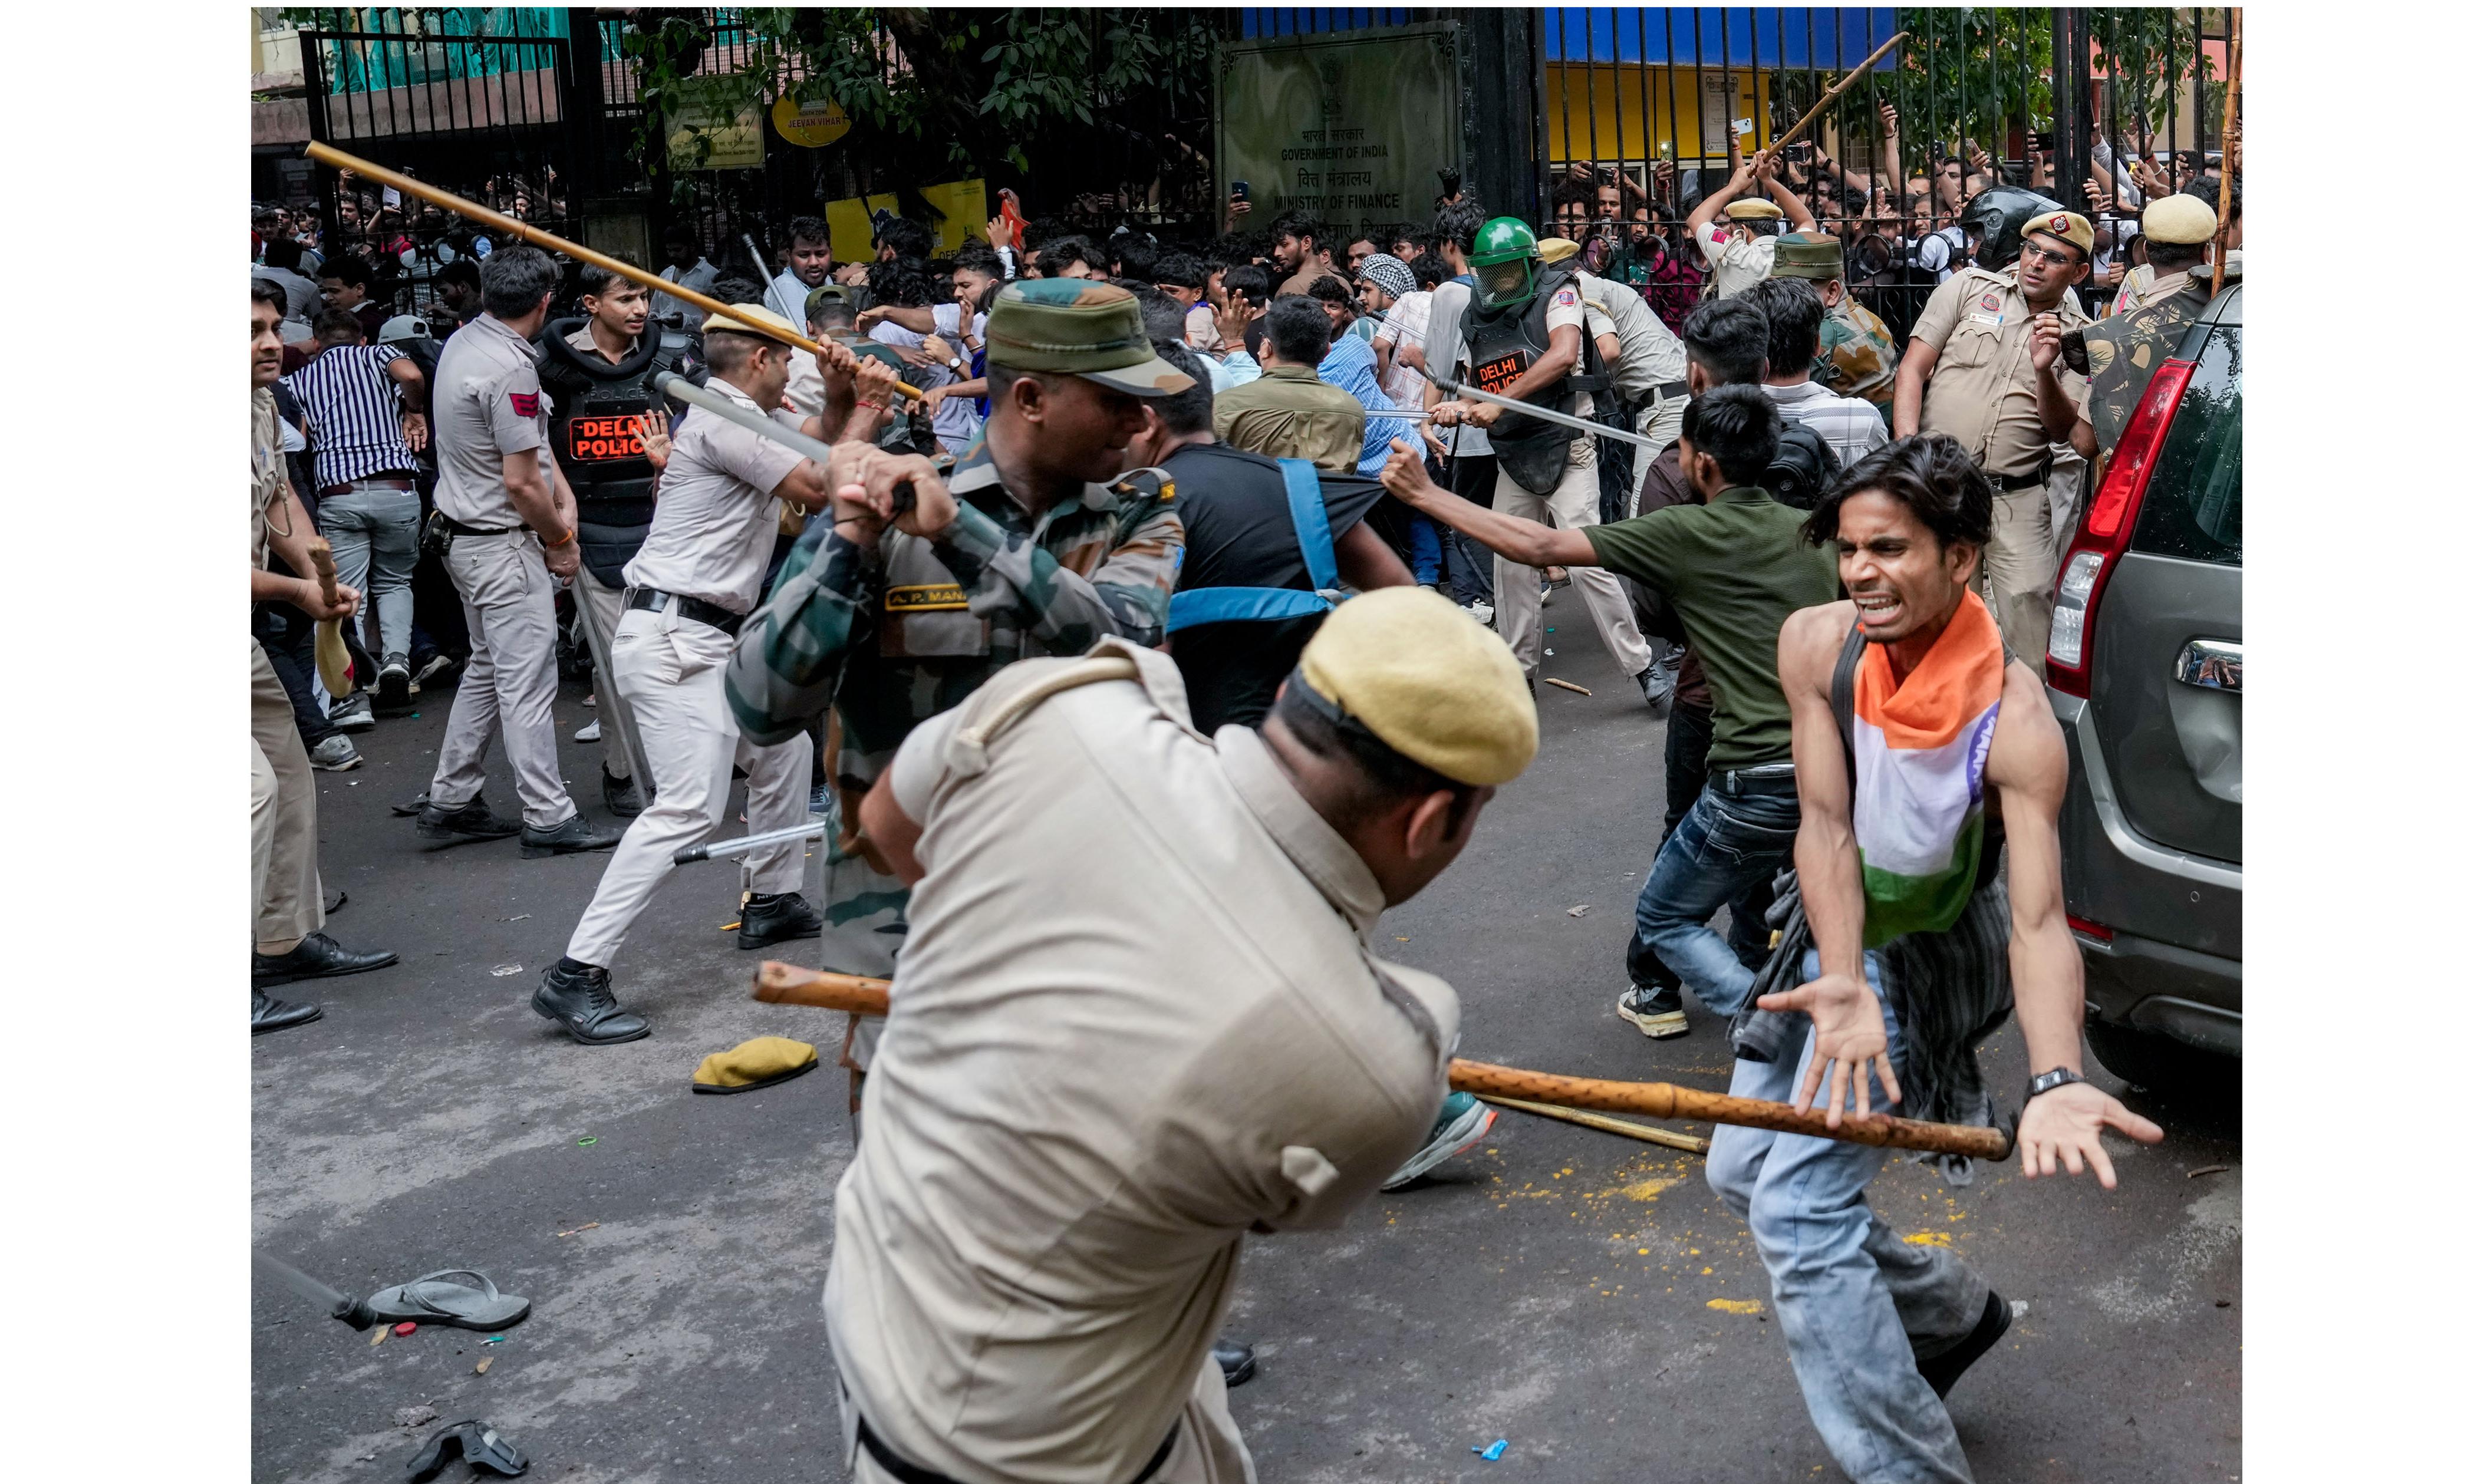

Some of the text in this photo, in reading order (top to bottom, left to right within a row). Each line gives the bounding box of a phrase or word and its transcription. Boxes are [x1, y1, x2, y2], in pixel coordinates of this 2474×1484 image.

[788, 117, 841, 128] JEEVAN VIHAR
[1302, 128, 1365, 143] भारत सरकार
[1282, 144, 1389, 161] GOVERNMENT OF INDIA
[1297, 167, 1372, 188] वित्त मंत्रालय
[1274, 193, 1399, 210] MINISTRY OF FINANCE
[1480, 358, 1517, 381] DELHI
[590, 388, 648, 400] POLICE
[577, 439, 645, 456] POLIC
[928, 591, 967, 602] MAN
